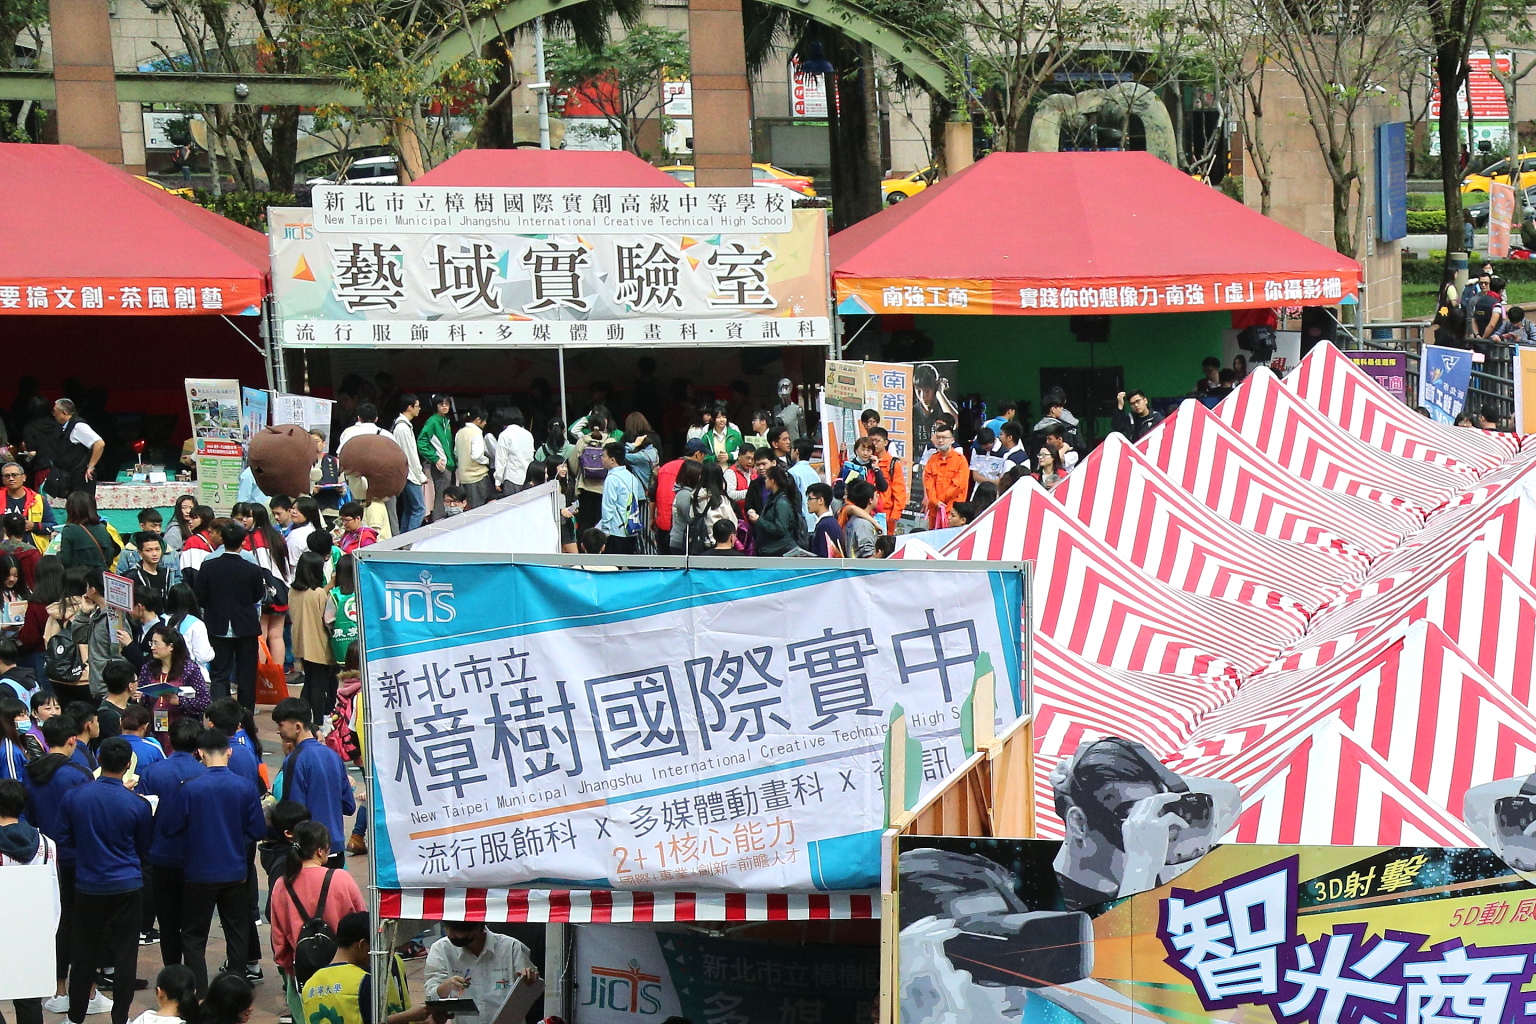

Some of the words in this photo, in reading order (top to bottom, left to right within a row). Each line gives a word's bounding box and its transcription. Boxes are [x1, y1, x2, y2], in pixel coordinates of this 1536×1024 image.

[324, 191, 785, 214] 新北市立樟樹國際實創高級中等學校
[324, 214, 344, 226] New
[350, 214, 388, 228] Taipei
[395, 214, 451, 228] Municipal
[459, 214, 511, 229] Jhangshu
[517, 215, 597, 227] International
[603, 215, 654, 227] Creative
[659, 215, 714, 227] Technical
[720, 215, 747, 228] High
[751, 215, 788, 227] School
[0, 286, 223, 309] 要搞文創-茶風創藝
[333, 242, 776, 310] 藝域實驗室
[882, 287, 968, 307] 南強工商
[292, 399, 304, 428] 樟樹
[377, 647, 537, 709] 新北市立
[387, 608, 980, 806] 樟樹國際實中
[411, 810, 438, 825] New
[444, 801, 489, 820] Taipei
[496, 785, 568, 810] Municipal
[577, 773, 643, 797] Jhangshu
[650, 748, 752, 785] International
[760, 735, 826, 759] Creative
[832, 722, 888, 744] Technic
[911, 711, 946, 729] High
[418, 819, 576, 874] 流行服飾科
[629, 770, 824, 838] 多媒體動畫科
[612, 816, 796, 875] 2+1核心能力
[1316, 853, 1427, 904] 3D射擊
[307, 983, 342, 999] 康寧大學
